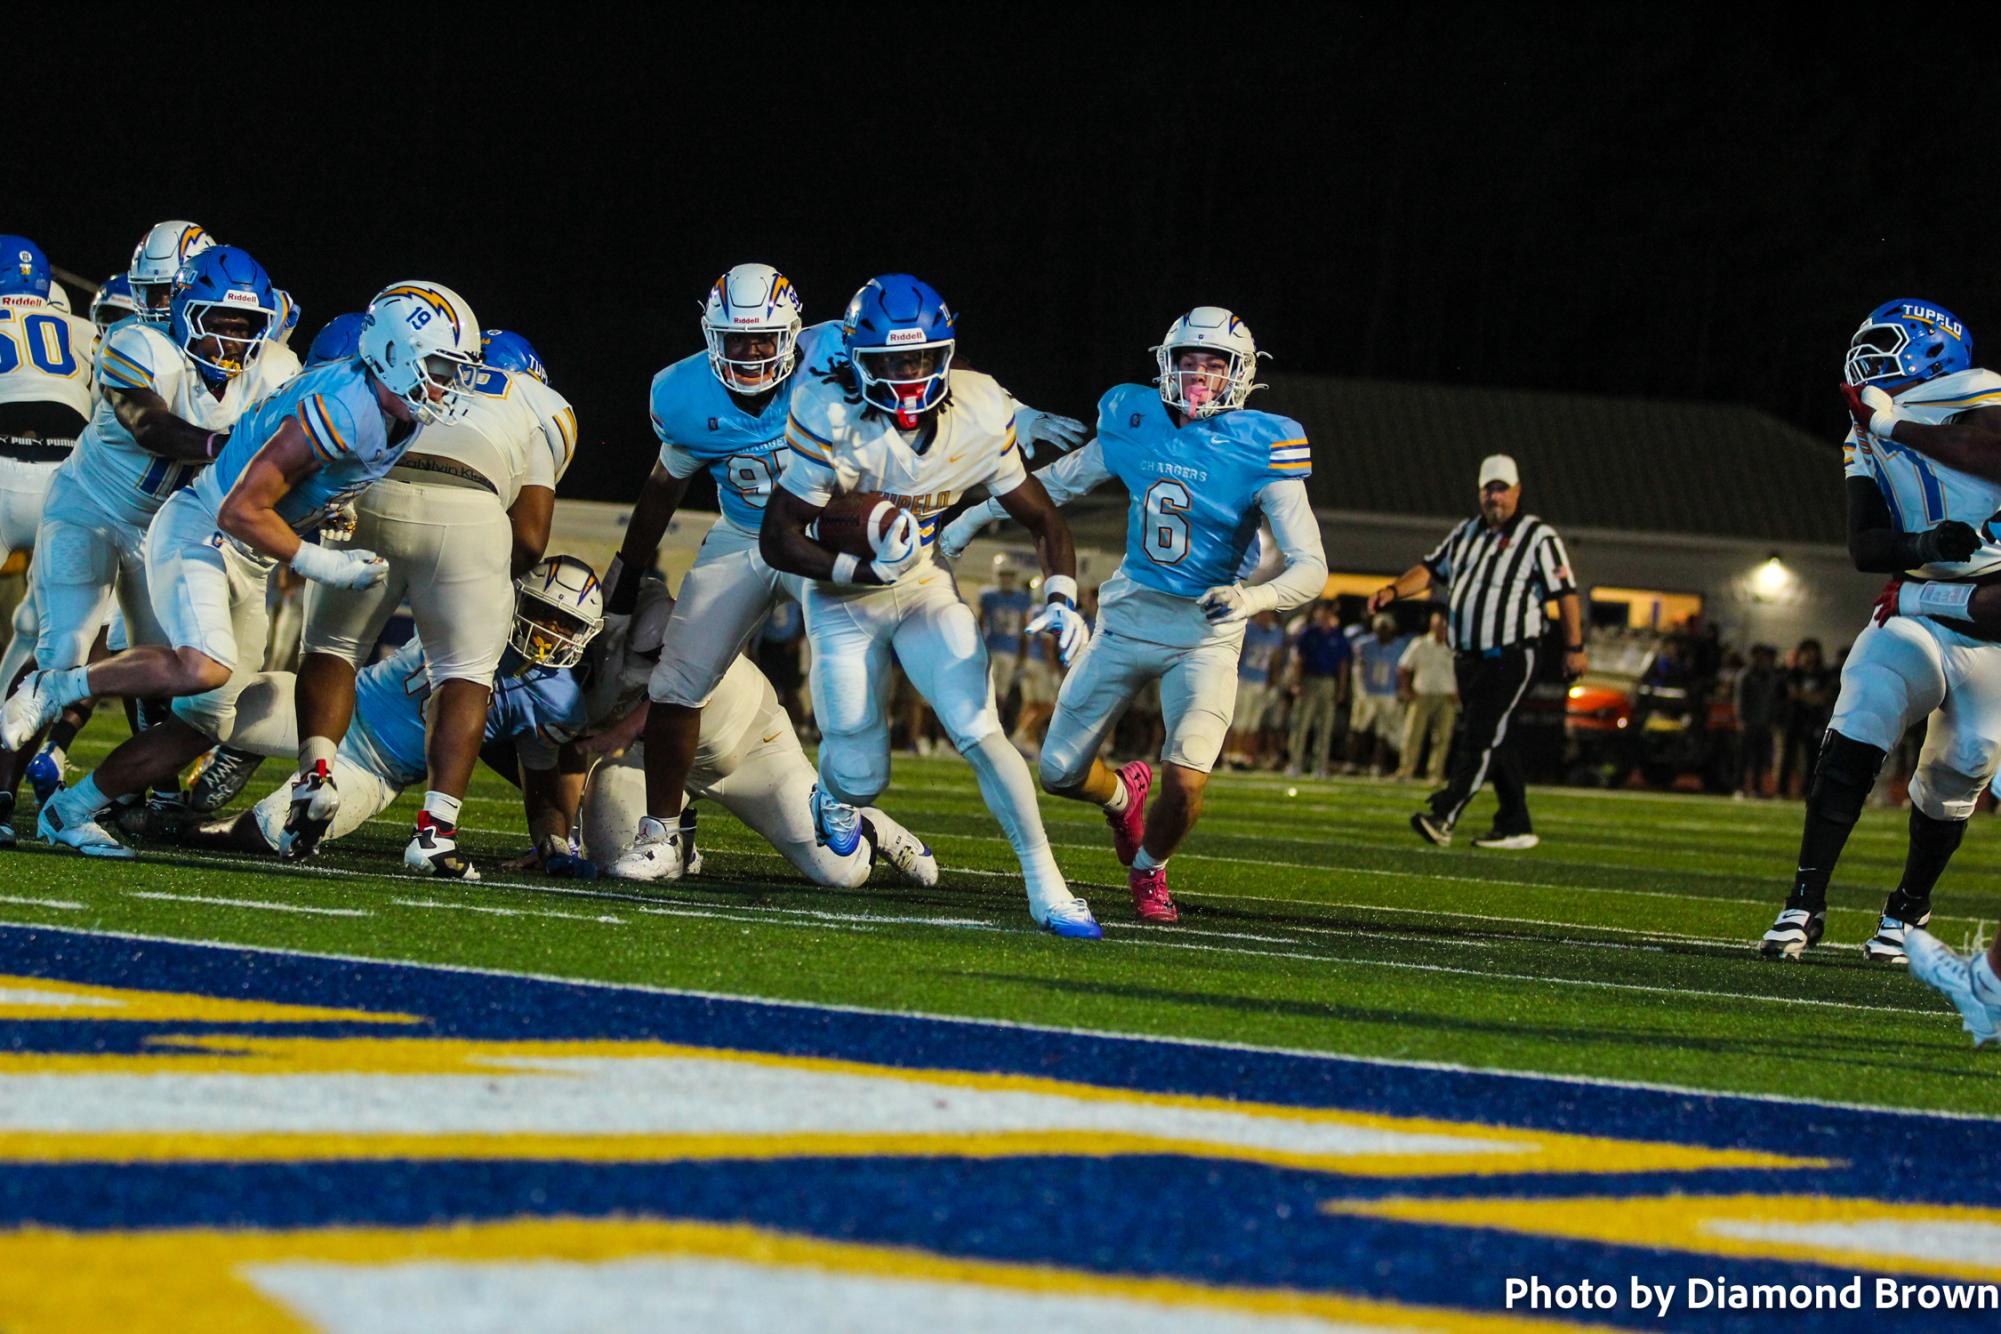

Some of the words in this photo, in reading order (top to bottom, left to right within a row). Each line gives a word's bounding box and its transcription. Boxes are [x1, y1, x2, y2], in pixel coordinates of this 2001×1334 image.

[2, 297, 42, 307] Riddell
[227, 292, 257, 303] Riddell
[405, 306, 431, 330] 19
[1902, 304, 1964, 336] TUPELO
[889, 332, 922, 342] Riddell
[1140, 460, 1208, 482] CHARGERS
[1142, 477, 1192, 565] 6
